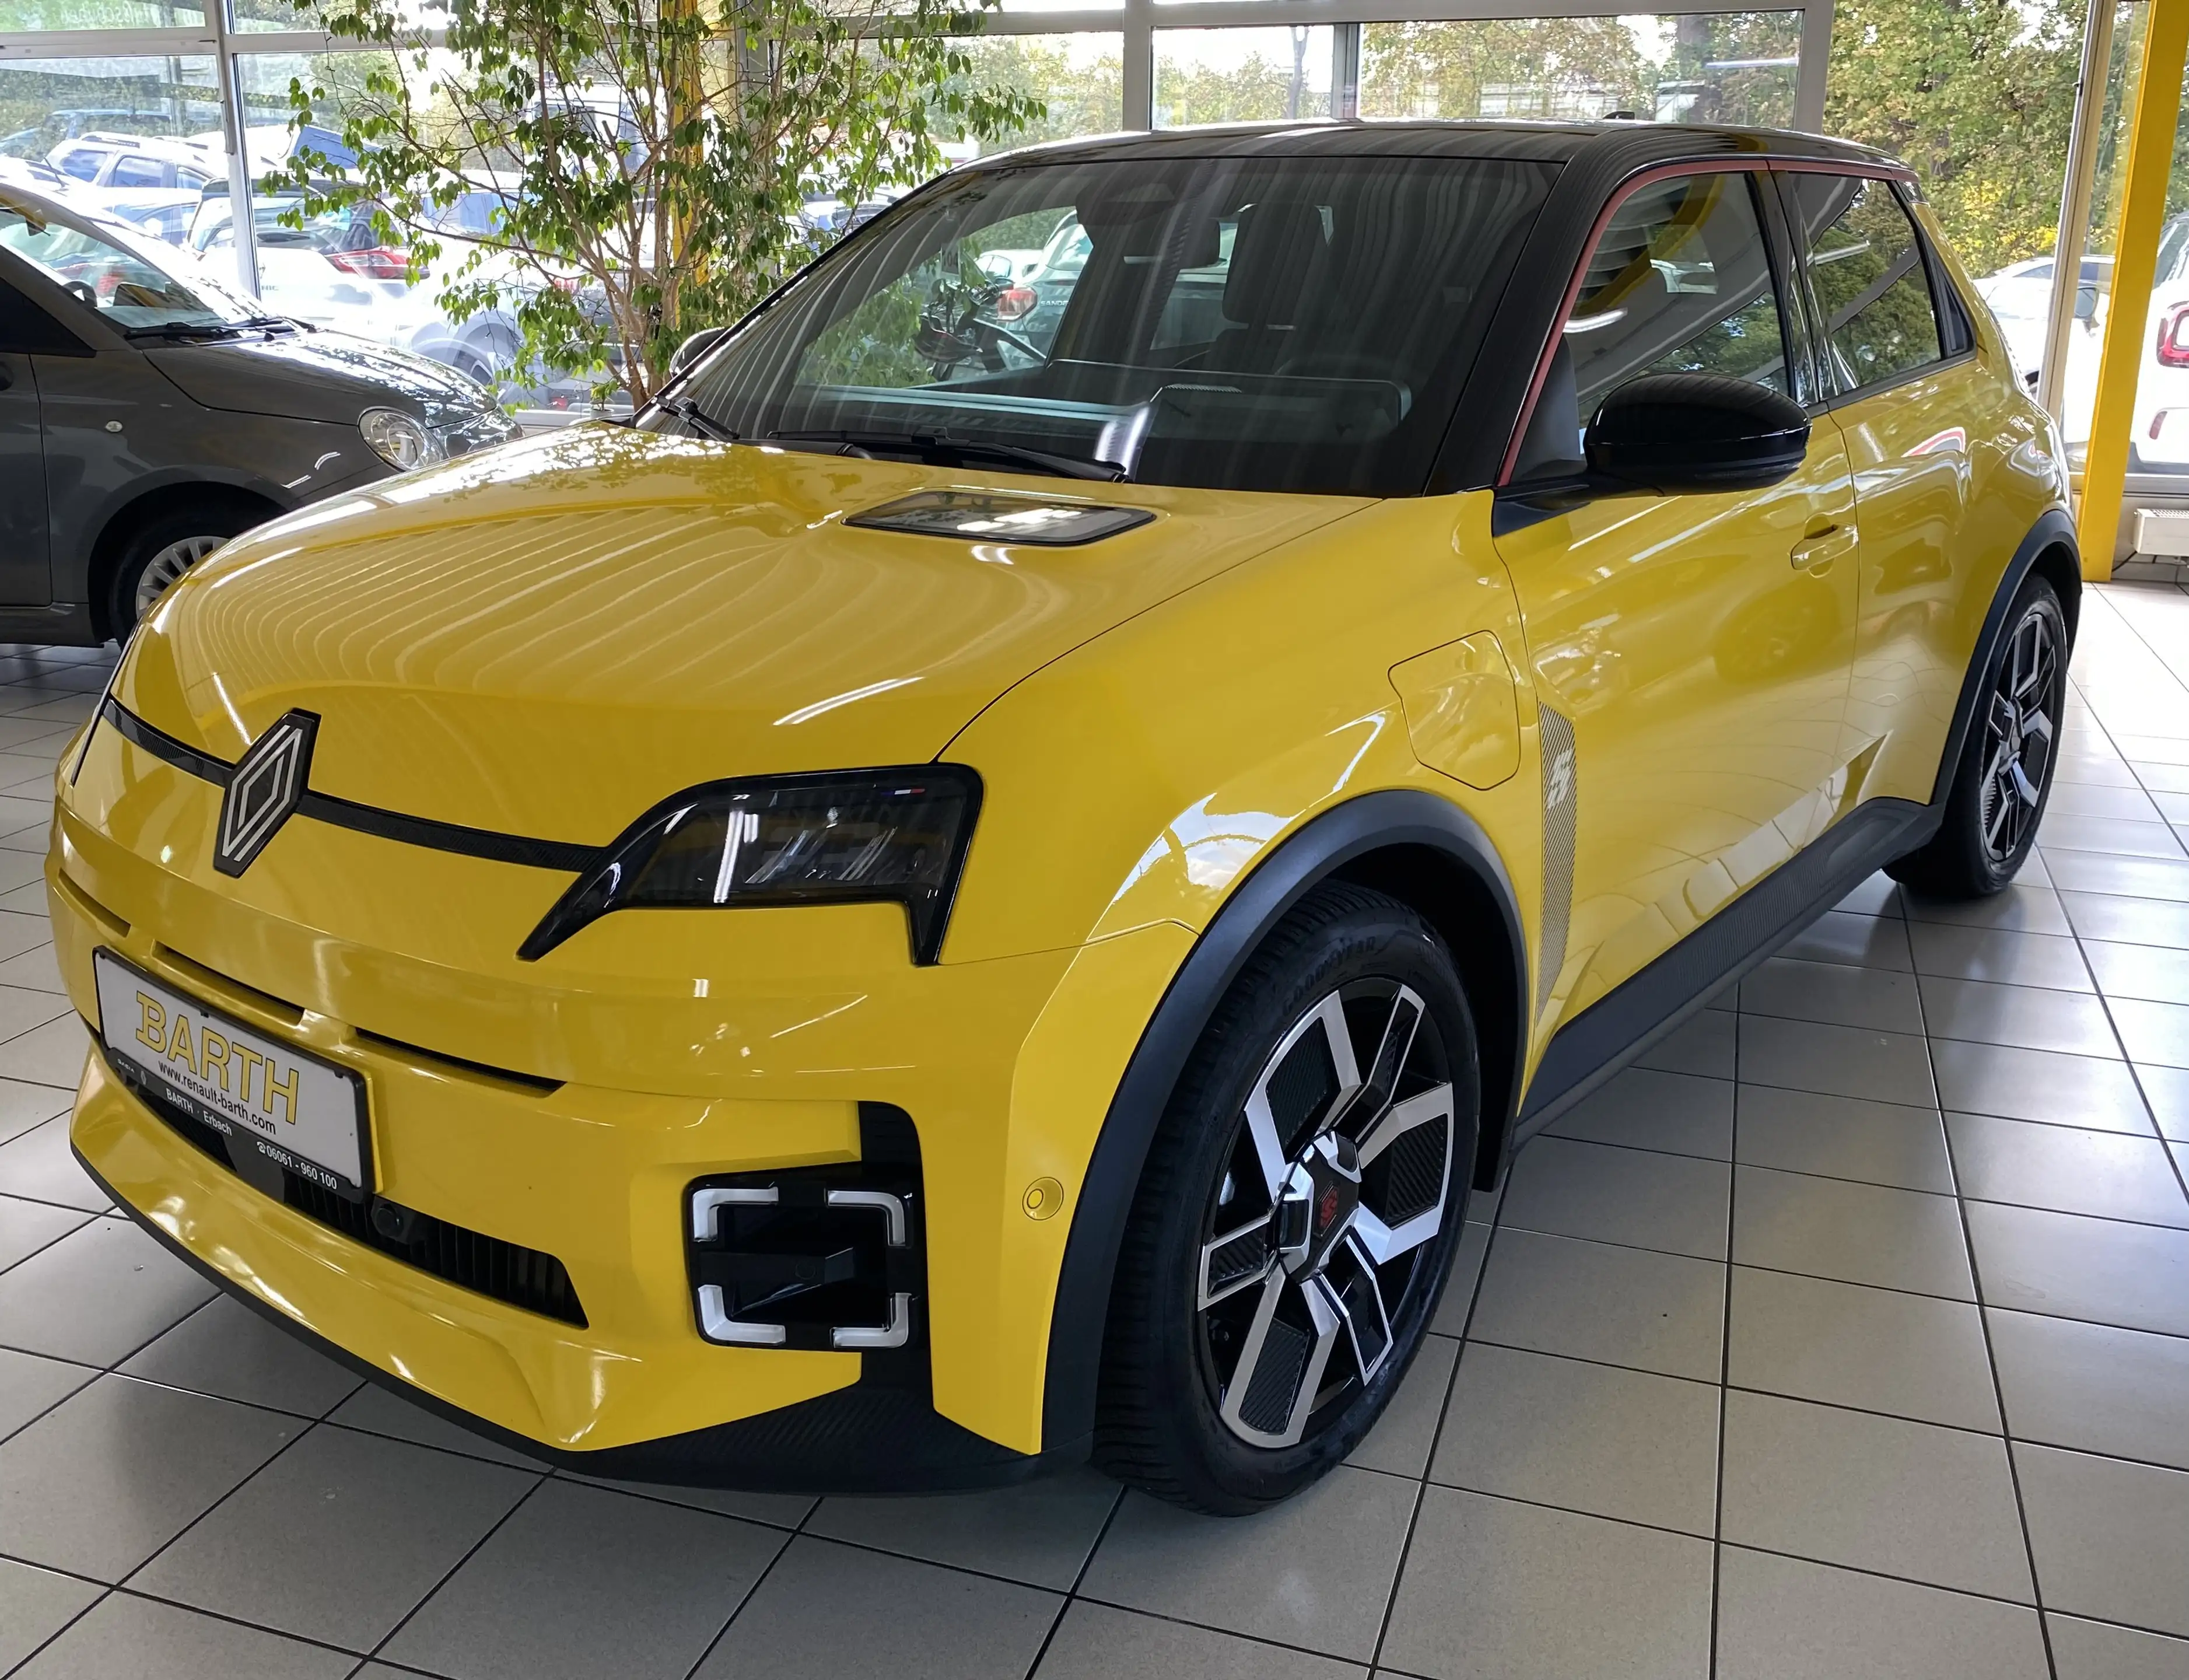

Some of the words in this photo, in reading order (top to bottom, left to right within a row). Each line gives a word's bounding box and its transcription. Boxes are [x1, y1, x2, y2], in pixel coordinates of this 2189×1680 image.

[135, 990, 299, 1125] BARTH
[158, 1060, 276, 1135] www.renault-barth.com
[166, 1088, 194, 1115] BARTH
[203, 1110, 232, 1136] Erbach
[267, 1145, 292, 1168] 06061
[300, 1162, 317, 1180] 960
[320, 1172, 337, 1189] 100
